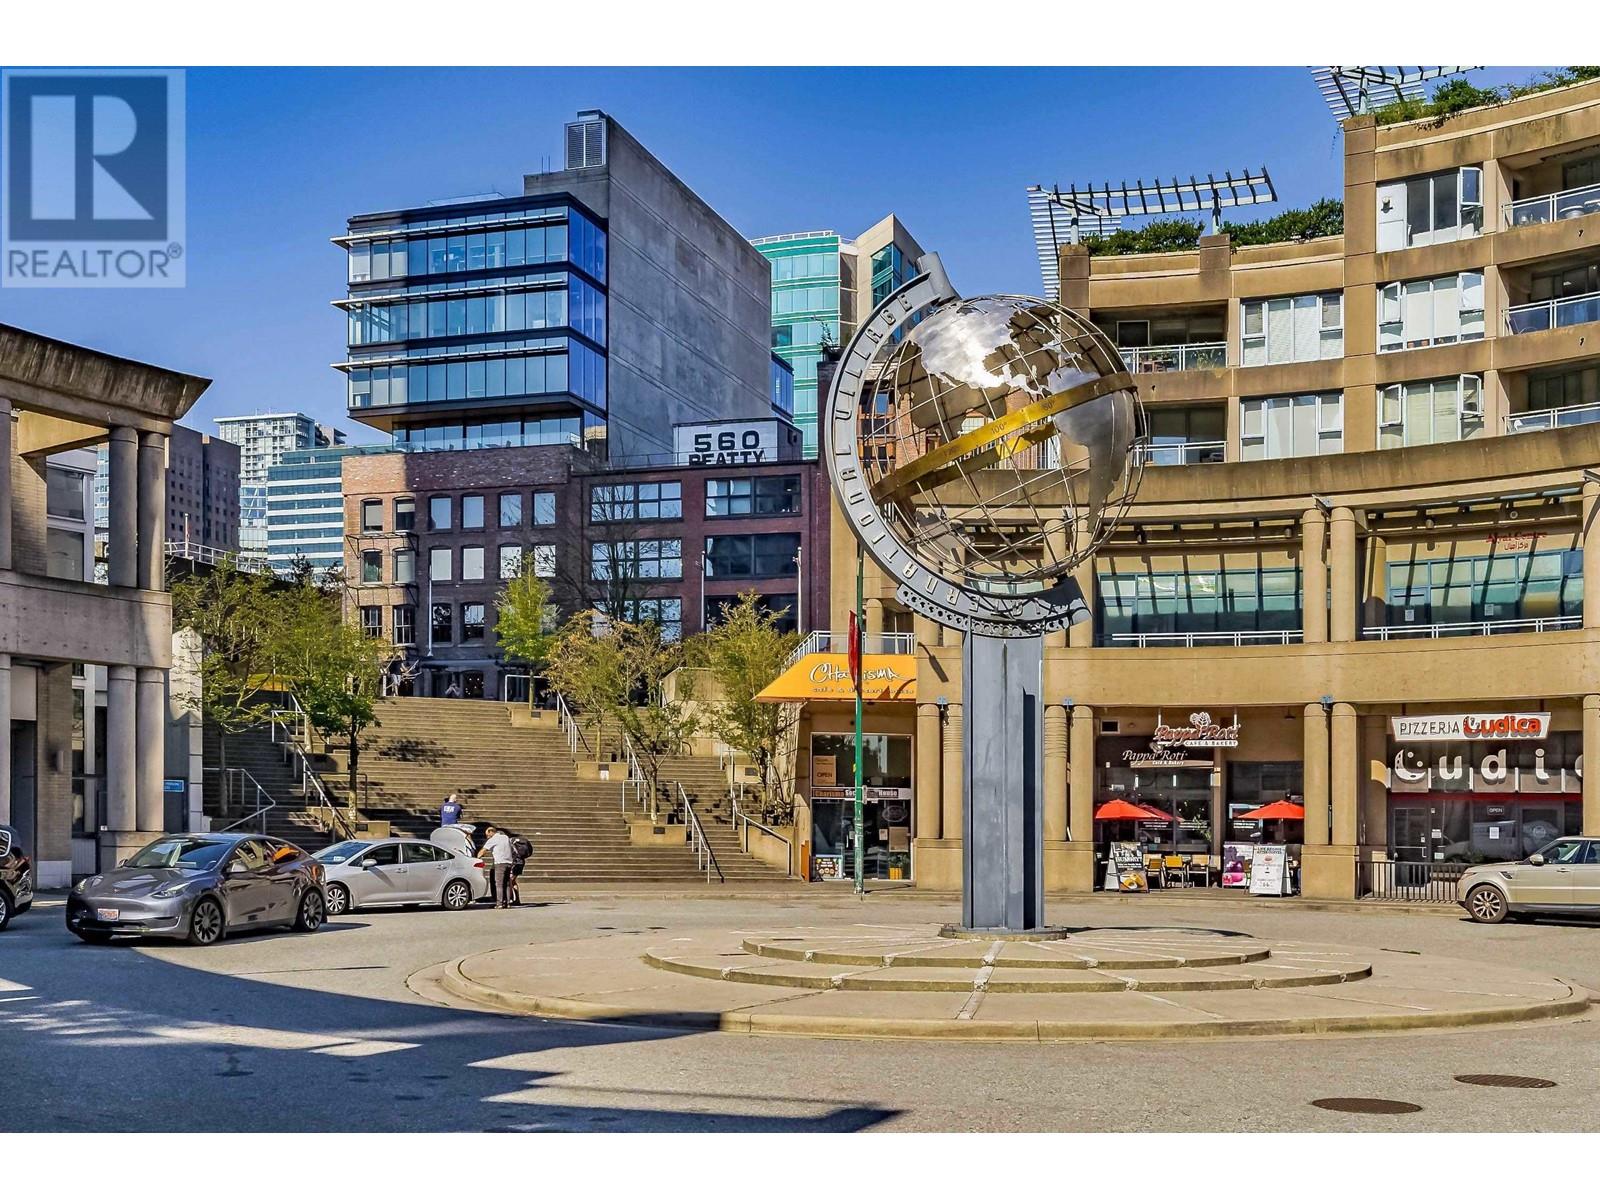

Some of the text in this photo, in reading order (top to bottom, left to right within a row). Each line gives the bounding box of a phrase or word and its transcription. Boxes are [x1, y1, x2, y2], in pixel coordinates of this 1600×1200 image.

[694, 430, 760, 452] 560
[1400, 721, 1460, 735] PIZZERIA
[1122, 750, 1156, 765] Pappa
